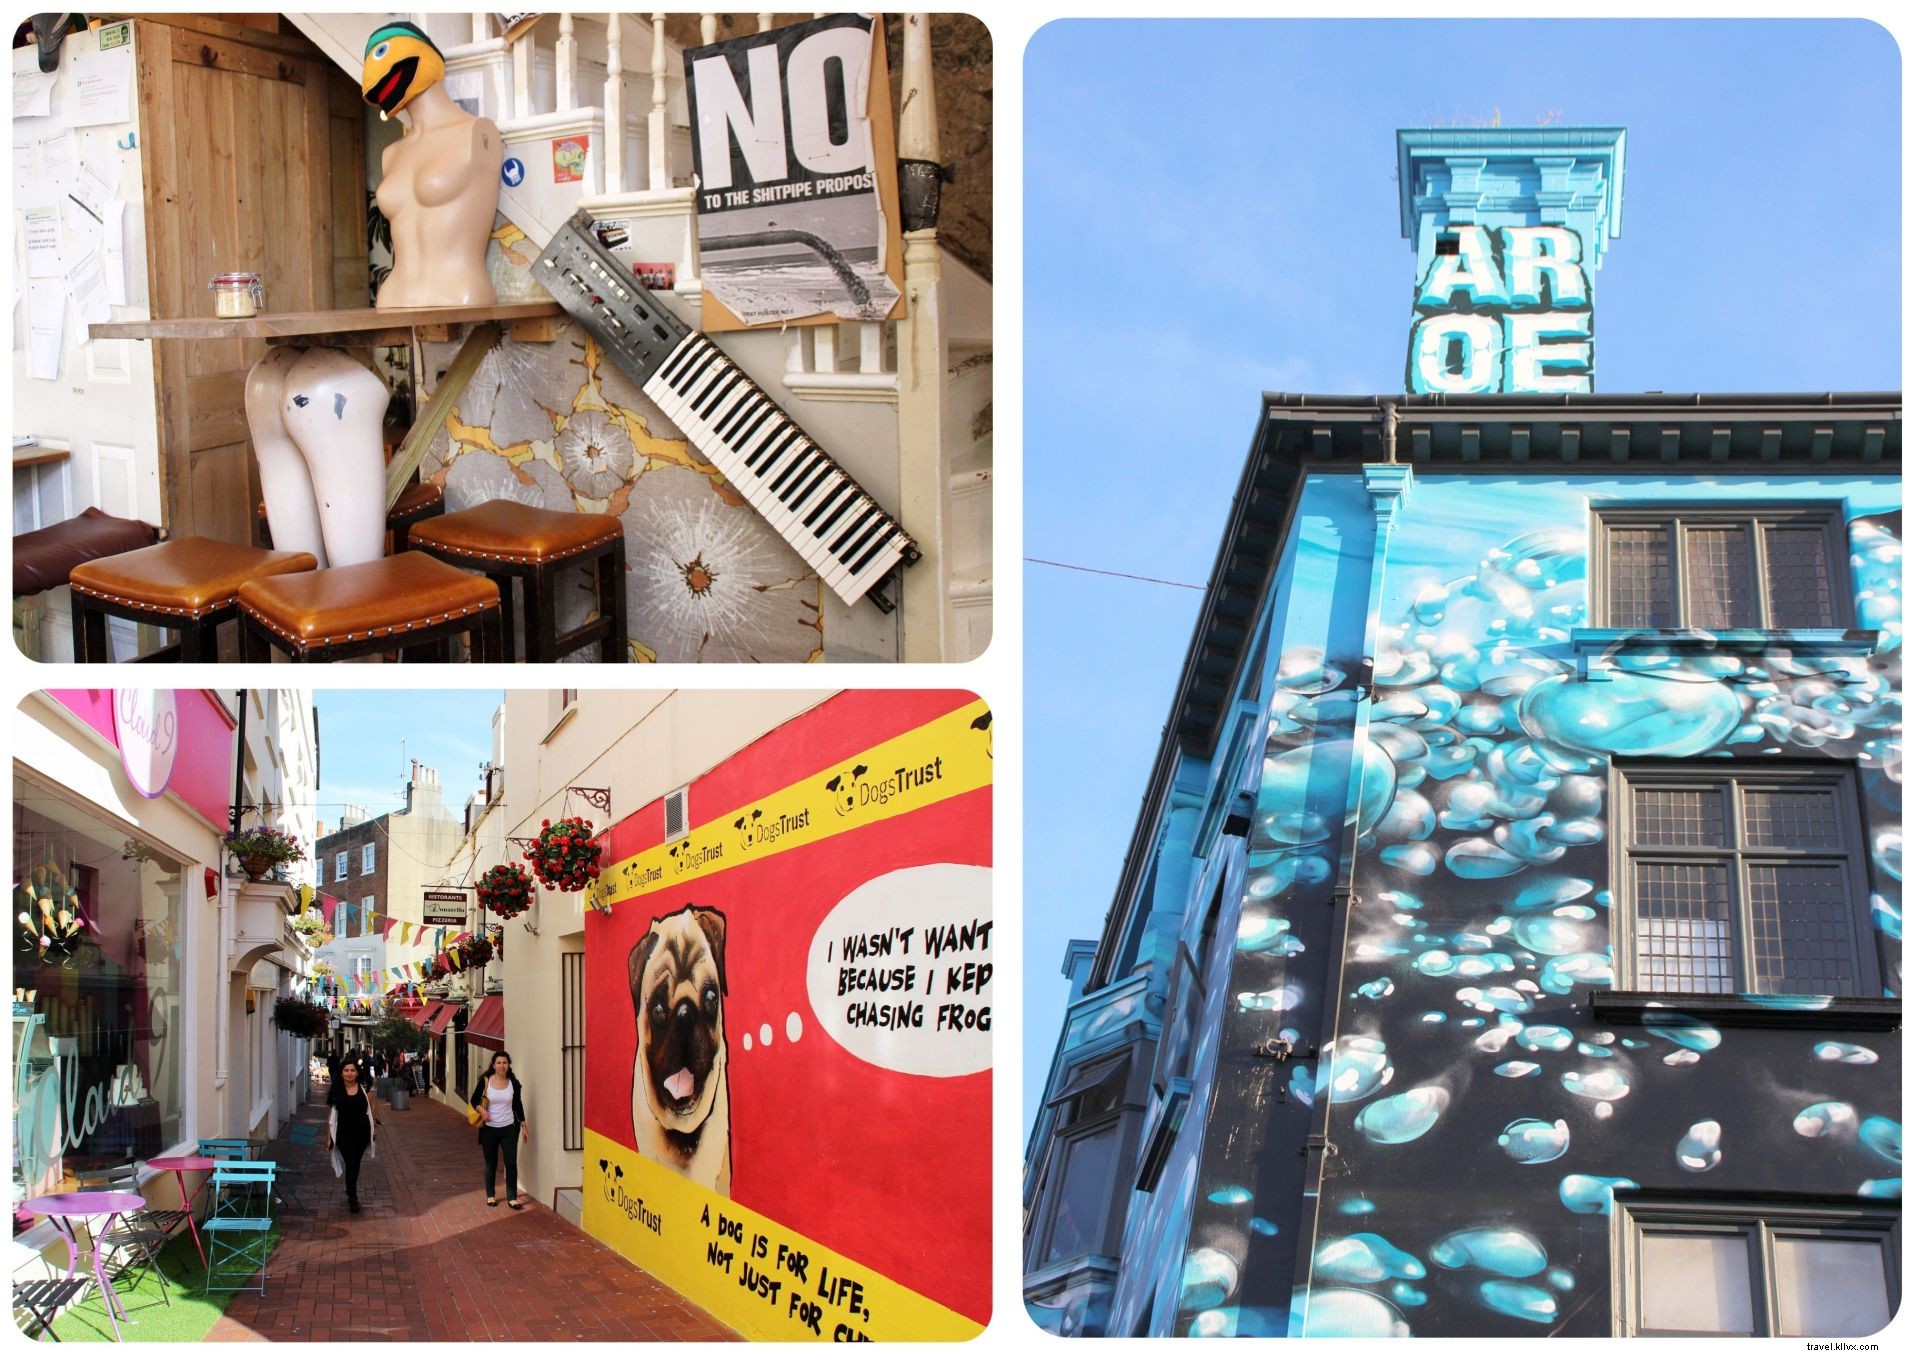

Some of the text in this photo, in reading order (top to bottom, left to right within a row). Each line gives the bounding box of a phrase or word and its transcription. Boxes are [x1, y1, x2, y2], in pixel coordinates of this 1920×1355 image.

[693, 27, 872, 190] NO
[704, 194, 721, 209] TO
[725, 190, 749, 206] THE
[753, 181, 812, 203] SHITPIPE
[860, 756, 942, 806] DogsTrust
[756, 808, 810, 843] DogsTrust
[827, 918, 993, 964] I WASN'T WANT
[837, 963, 993, 996] BECAUSE I KEP
[846, 1000, 992, 1033] CHASING FROG
[618, 1185, 662, 1237] DogsTrust
[700, 1203, 870, 1323] A DOG IS FOR LIFE,
[707, 1241, 734, 1275] NOT
[738, 1261, 782, 1306] JUST
[789, 1292, 822, 1337] FOR
